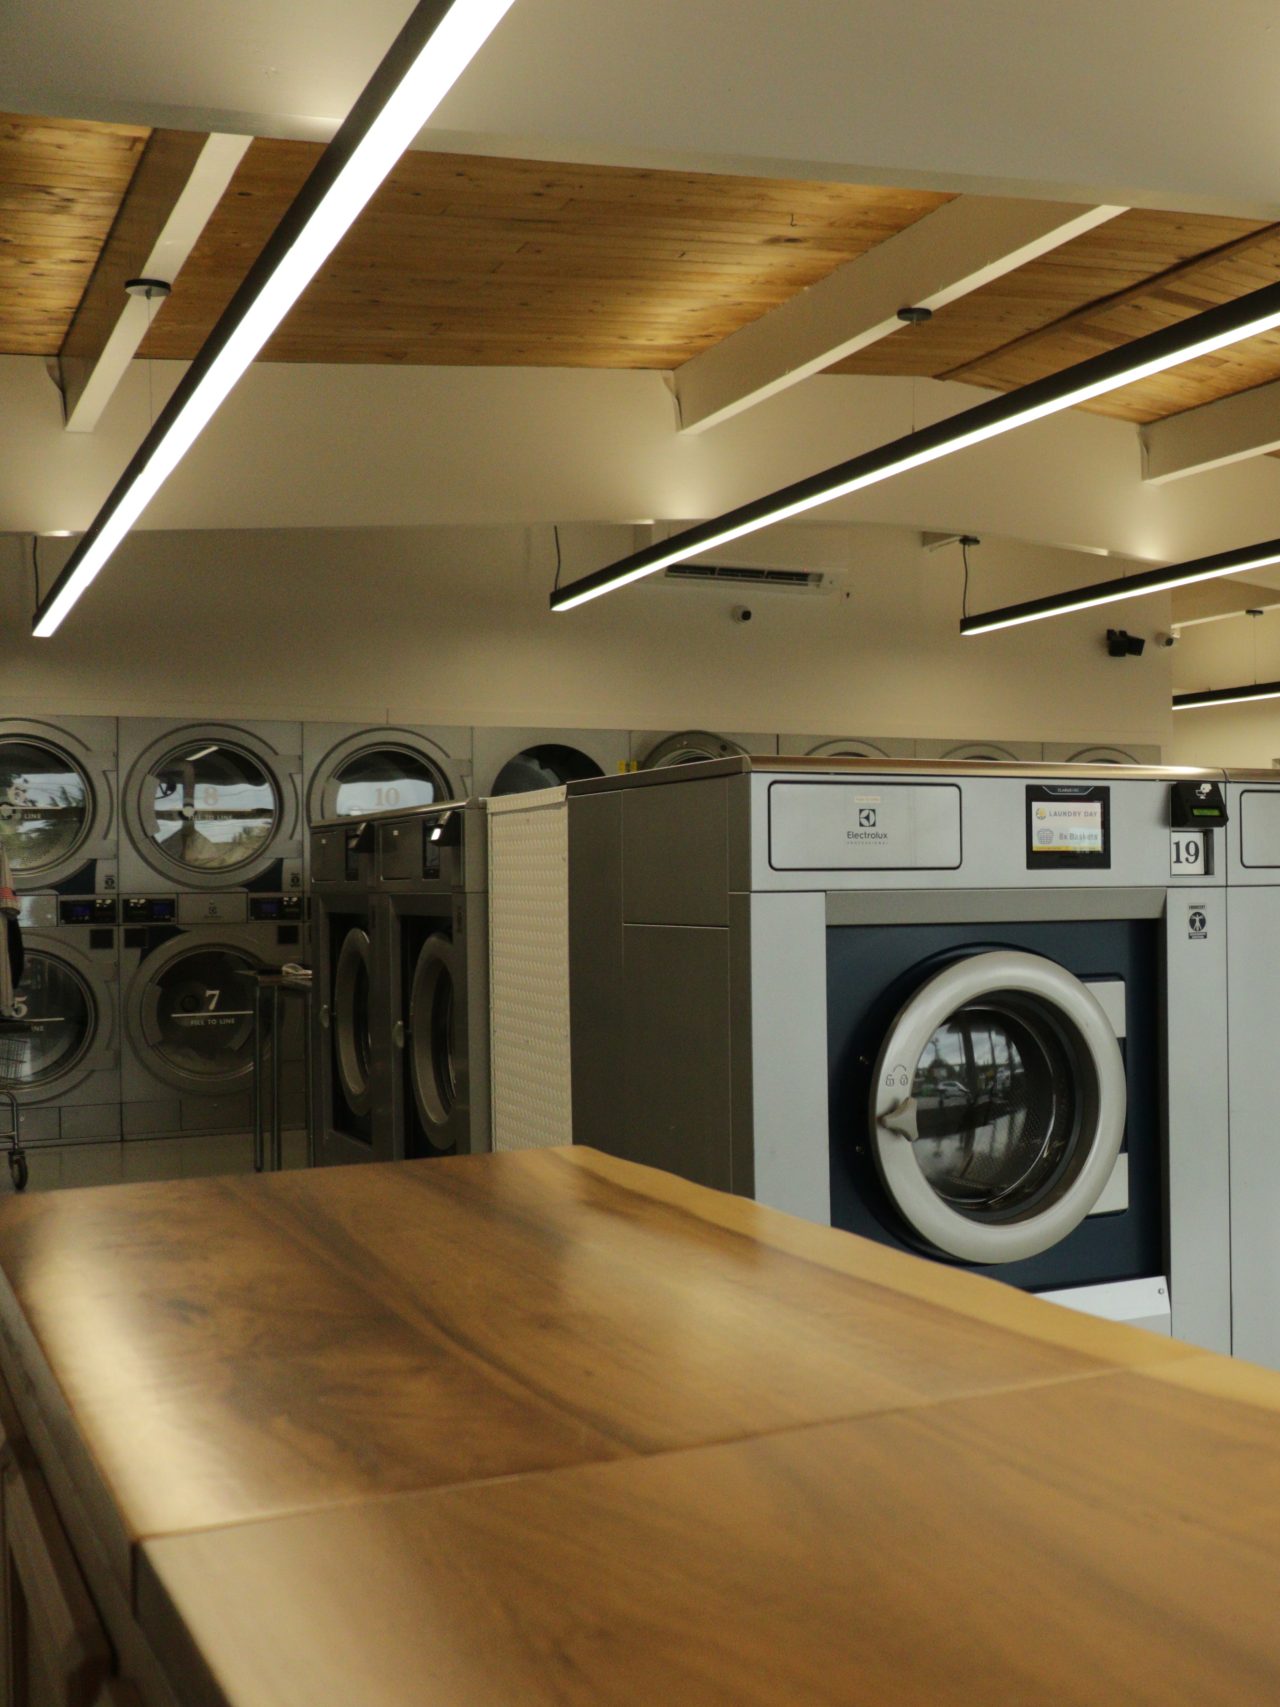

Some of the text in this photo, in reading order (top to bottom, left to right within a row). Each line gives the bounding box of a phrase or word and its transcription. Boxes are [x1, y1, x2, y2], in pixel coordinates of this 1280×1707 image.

[203, 787, 219, 806] 8
[375, 787, 400, 806] 10
[1048, 810, 1098, 818] LAUNDRY DAY
[846, 830, 889, 840] Electrolux
[1172, 840, 1200, 864] 19
[12, 996, 28, 1018] 5
[205, 989, 220, 1011] 7
